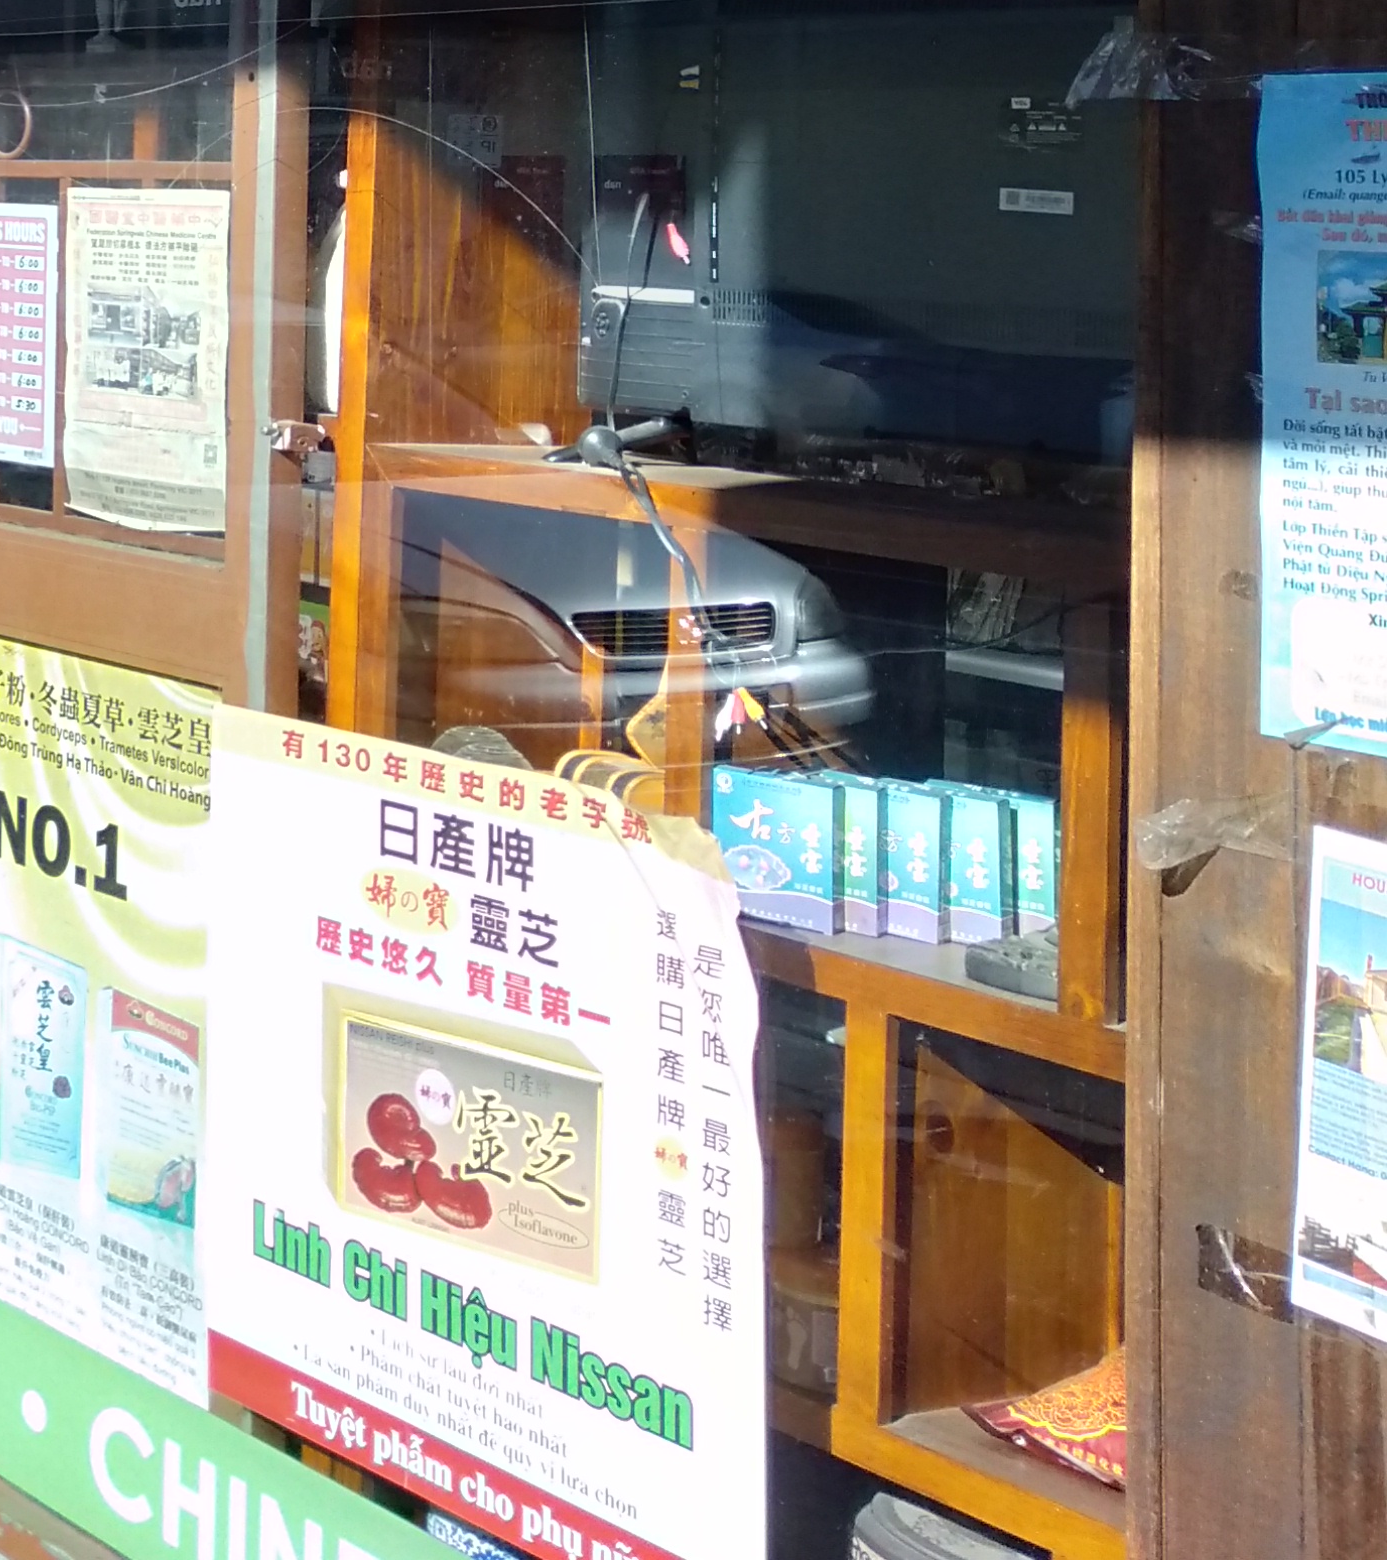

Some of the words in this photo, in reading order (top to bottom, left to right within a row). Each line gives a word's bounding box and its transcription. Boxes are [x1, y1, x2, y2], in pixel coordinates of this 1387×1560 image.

[1334, 169, 1366, 185] 105
[1302, 188, 1347, 202] (Email:
[5, 221, 46, 244] HOURS
[1283, 438, 1299, 452] và
[1309, 419, 1342, 440] sống
[1282, 576, 1315, 595] Hoạt
[1320, 581, 1358, 604] Động
[31, 717, 88, 747] Cordyceps
[99, 735, 149, 762] Trametes
[151, 749, 210, 780] Versicolor
[120, 767, 144, 789] Vân
[146, 775, 167, 796] Chi
[169, 782, 212, 812] Hoàng
[282, 729, 653, 844] 有130年歷史的老字號
[379, 797, 535, 893] 日產牌
[365, 872, 450, 932] 婦の寶
[469, 893, 560, 969] 靈芝
[316, 915, 444, 987] 歷史悠久
[465, 960, 612, 1027] 質量第一
[454, 1088, 588, 1210] 靈芝
[692, 944, 733, 1333] 是您唯一最好的選擇
[1308, 1143, 1346, 1166] Contact
[508, 1200, 535, 1218] plus
[41, 1220, 90, 1254] CONCORD
[513, 1214, 578, 1245] Isoflavone
[149, 1275, 203, 1311] CONCORD
[252, 1198, 332, 1289] Linh
[342, 1239, 408, 1323] Chi
[419, 1268, 519, 1370] Hiệu
[530, 1315, 695, 1452] Nissan
[290, 1380, 368, 1450] Tuyệt
[373, 1429, 454, 1493] phẩm
[459, 1471, 515, 1523] cho
[520, 1503, 584, 1560] phụ
[594, 1486, 639, 1520] chọn
